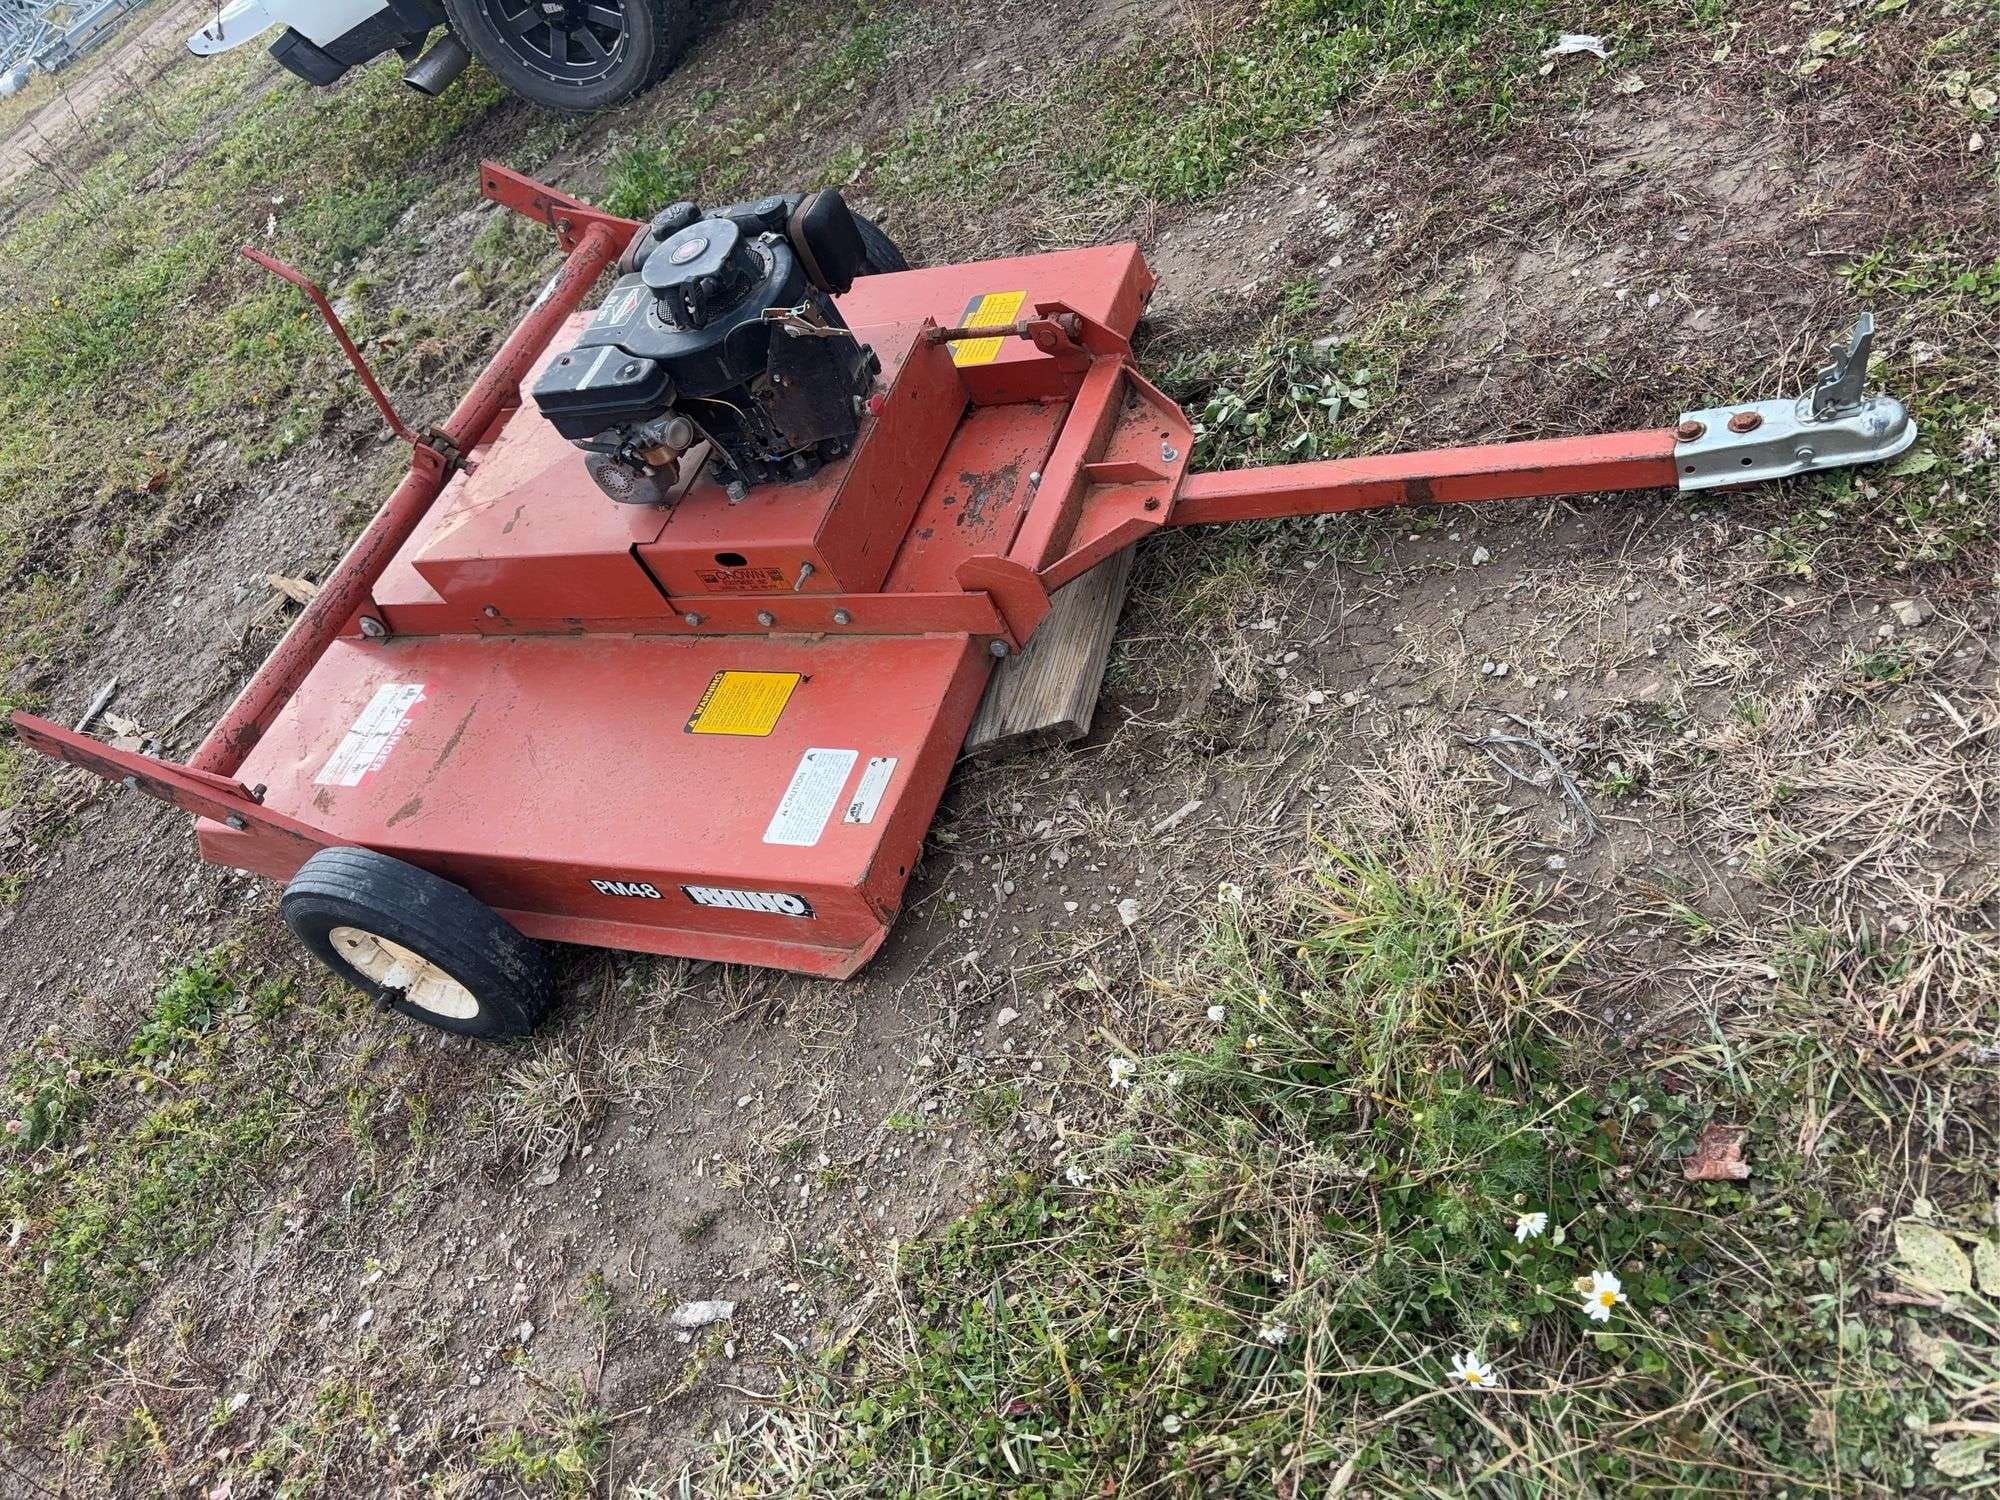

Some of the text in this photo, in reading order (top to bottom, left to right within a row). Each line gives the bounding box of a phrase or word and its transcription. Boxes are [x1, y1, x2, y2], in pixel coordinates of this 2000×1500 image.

[693, 671, 724, 715] WARNING
[368, 718, 414, 773] DANGER
[783, 771, 807, 808] CAUTION
[590, 879, 662, 899] PM48
[685, 885, 808, 915] RHINO
